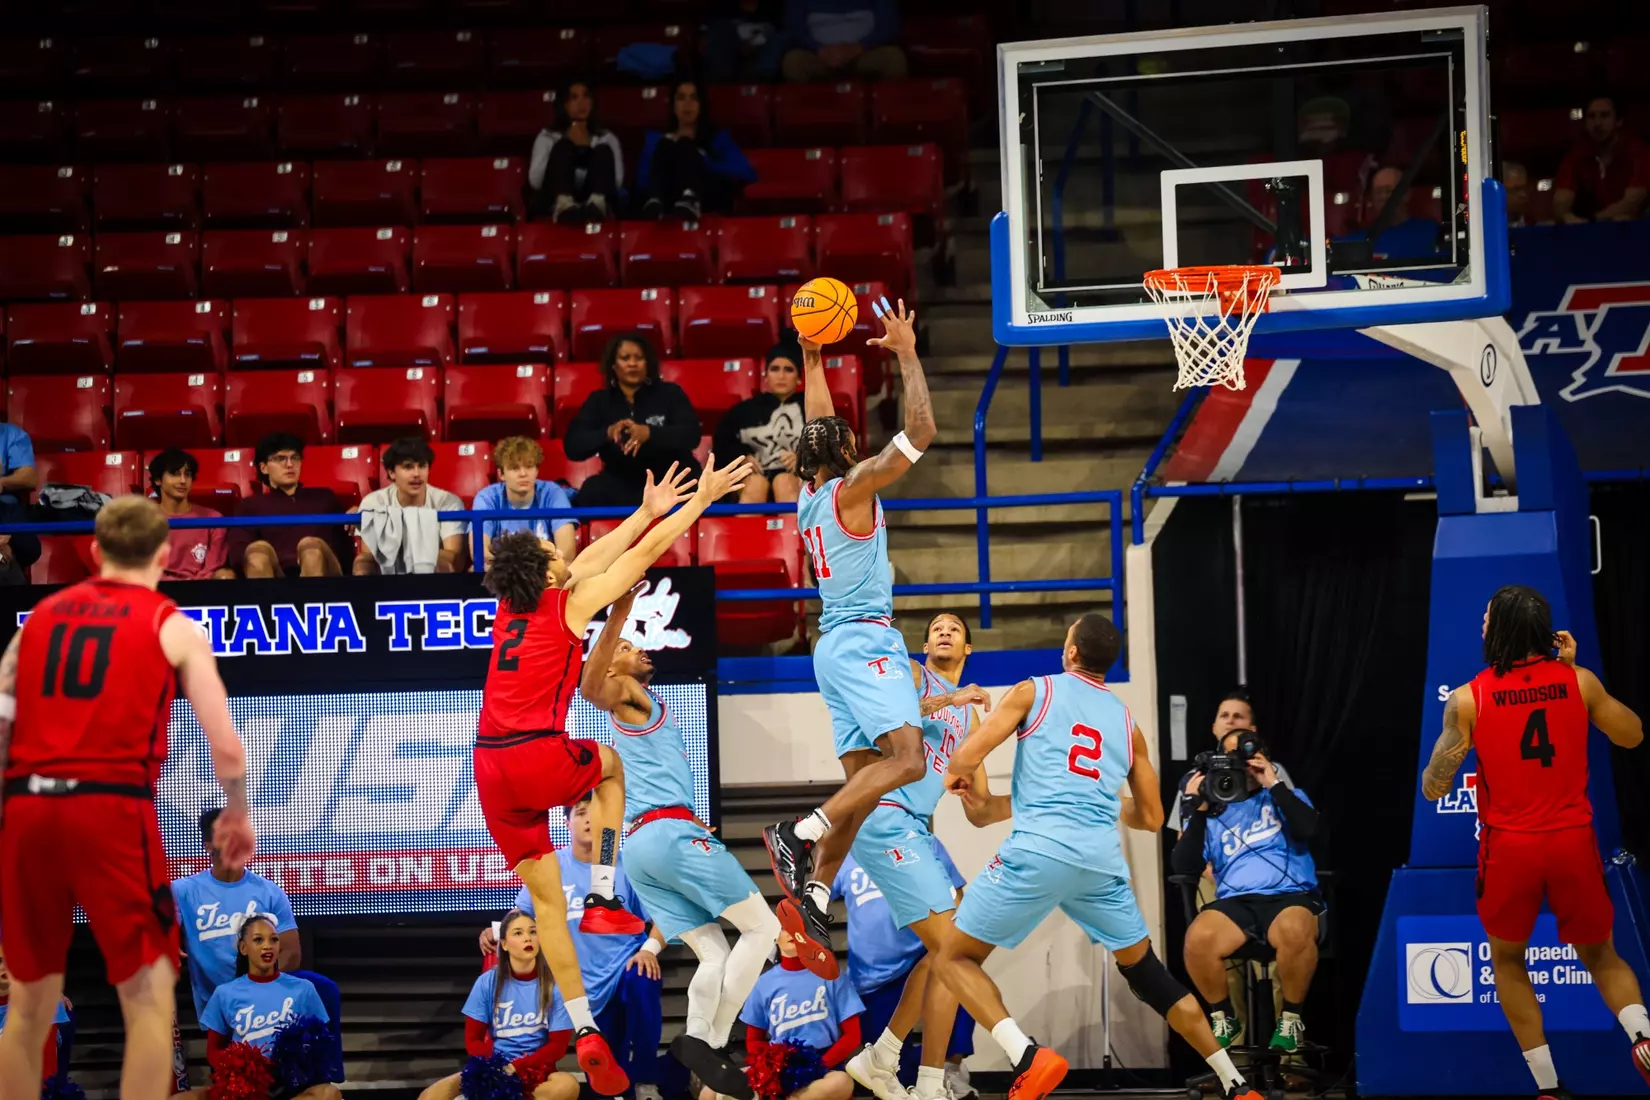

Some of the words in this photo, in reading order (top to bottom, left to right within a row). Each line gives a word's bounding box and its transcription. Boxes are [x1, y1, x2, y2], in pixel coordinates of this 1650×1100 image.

[1028, 312, 1073, 325] SPALDING
[803, 525, 832, 579] 11
[376, 599, 500, 650] TEC
[497, 618, 529, 671] 2
[42, 622, 117, 699] 10
[1492, 683, 1569, 707] WOODSON
[923, 740, 948, 774] TE
[1068, 722, 1103, 781] 2
[1520, 708, 1556, 768] 4
[240, 711, 487, 835] US
[368, 855, 433, 884] ON
[235, 996, 297, 1037] Tech
[769, 984, 828, 1026] Tech
[1480, 991, 1492, 1003] of
